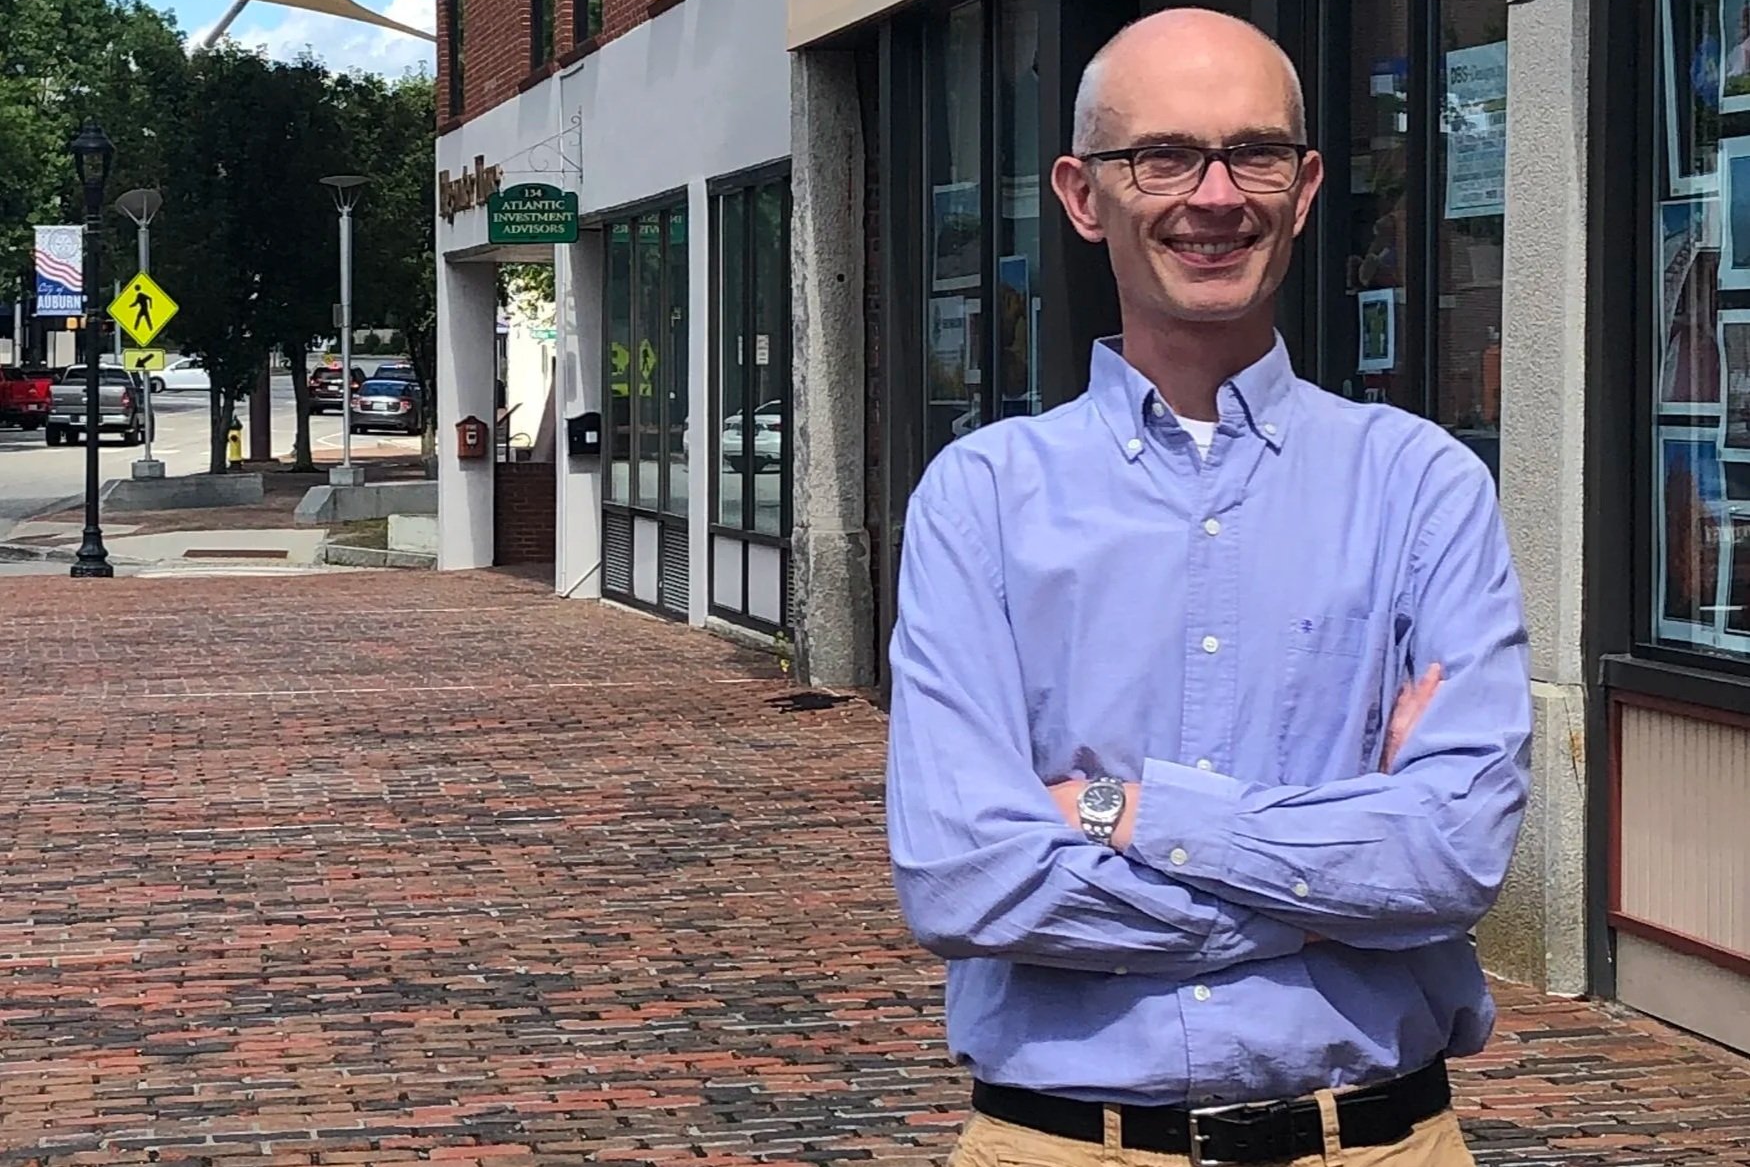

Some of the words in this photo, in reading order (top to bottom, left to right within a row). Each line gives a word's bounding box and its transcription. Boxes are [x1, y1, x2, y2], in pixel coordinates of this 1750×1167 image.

[501, 200, 566, 210] ATLANTIC
[493, 212, 574, 222] INVESTMENT
[502, 224, 565, 234] ADVISORS
[37, 294, 81, 309] AUBURN
